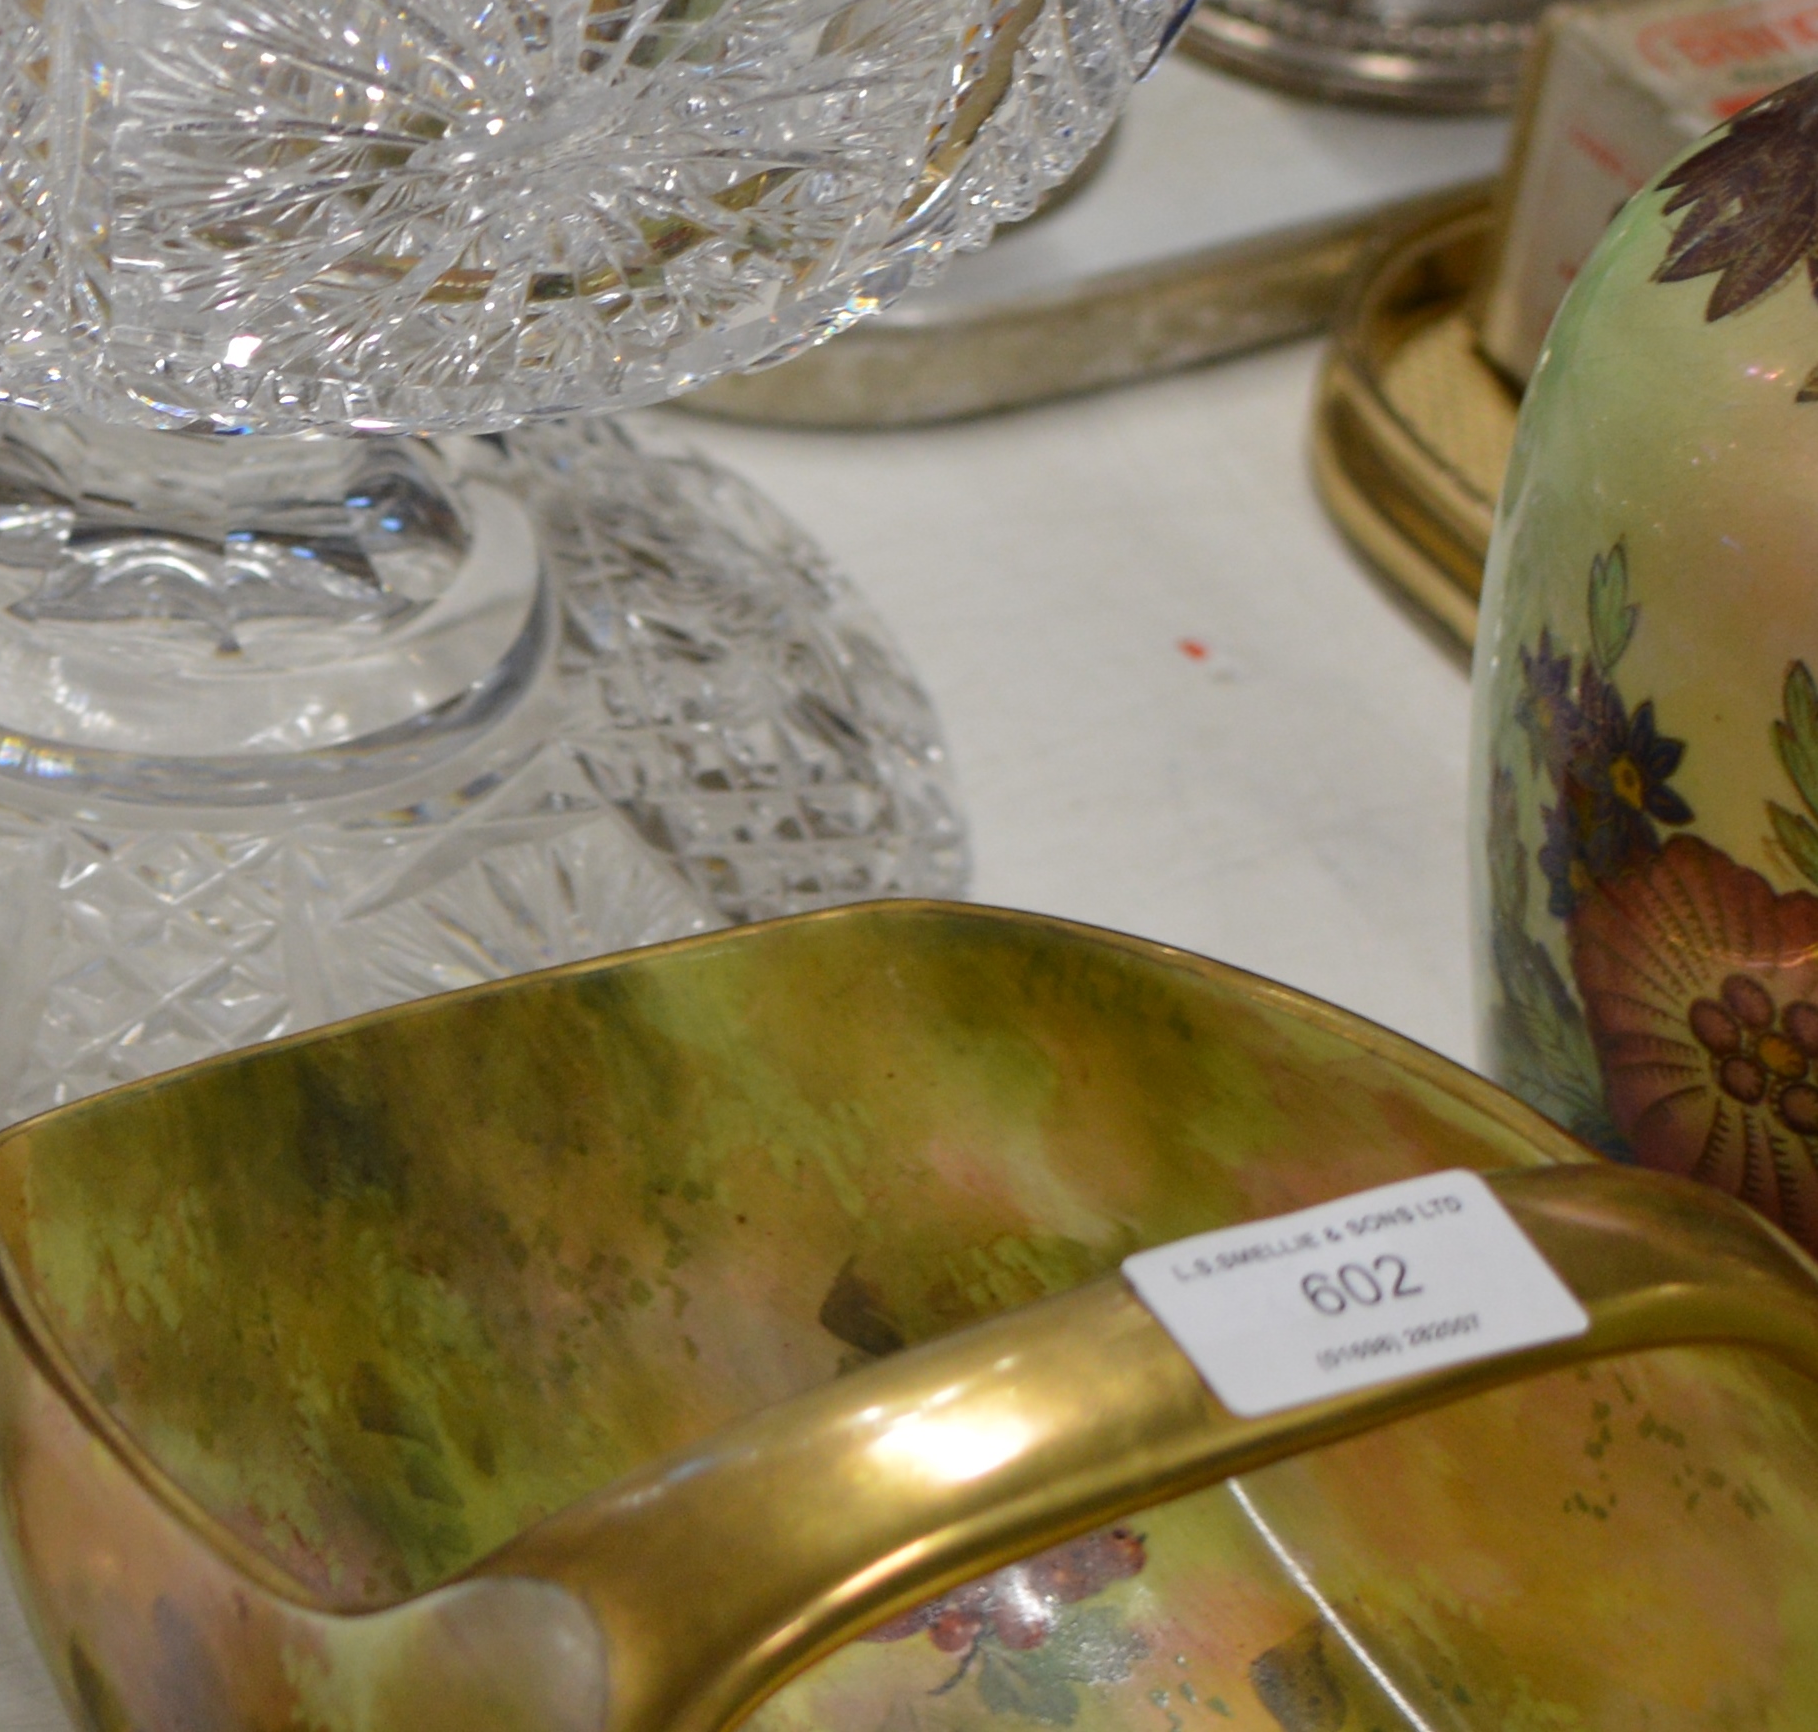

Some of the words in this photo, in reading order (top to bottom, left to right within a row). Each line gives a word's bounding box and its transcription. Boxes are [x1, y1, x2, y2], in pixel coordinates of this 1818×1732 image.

[1324, 1226, 1342, 1243] &
[1346, 1206, 1414, 1237] SONS
[1417, 1195, 1462, 1222] LTD
[1301, 1254, 1425, 1317] 602
